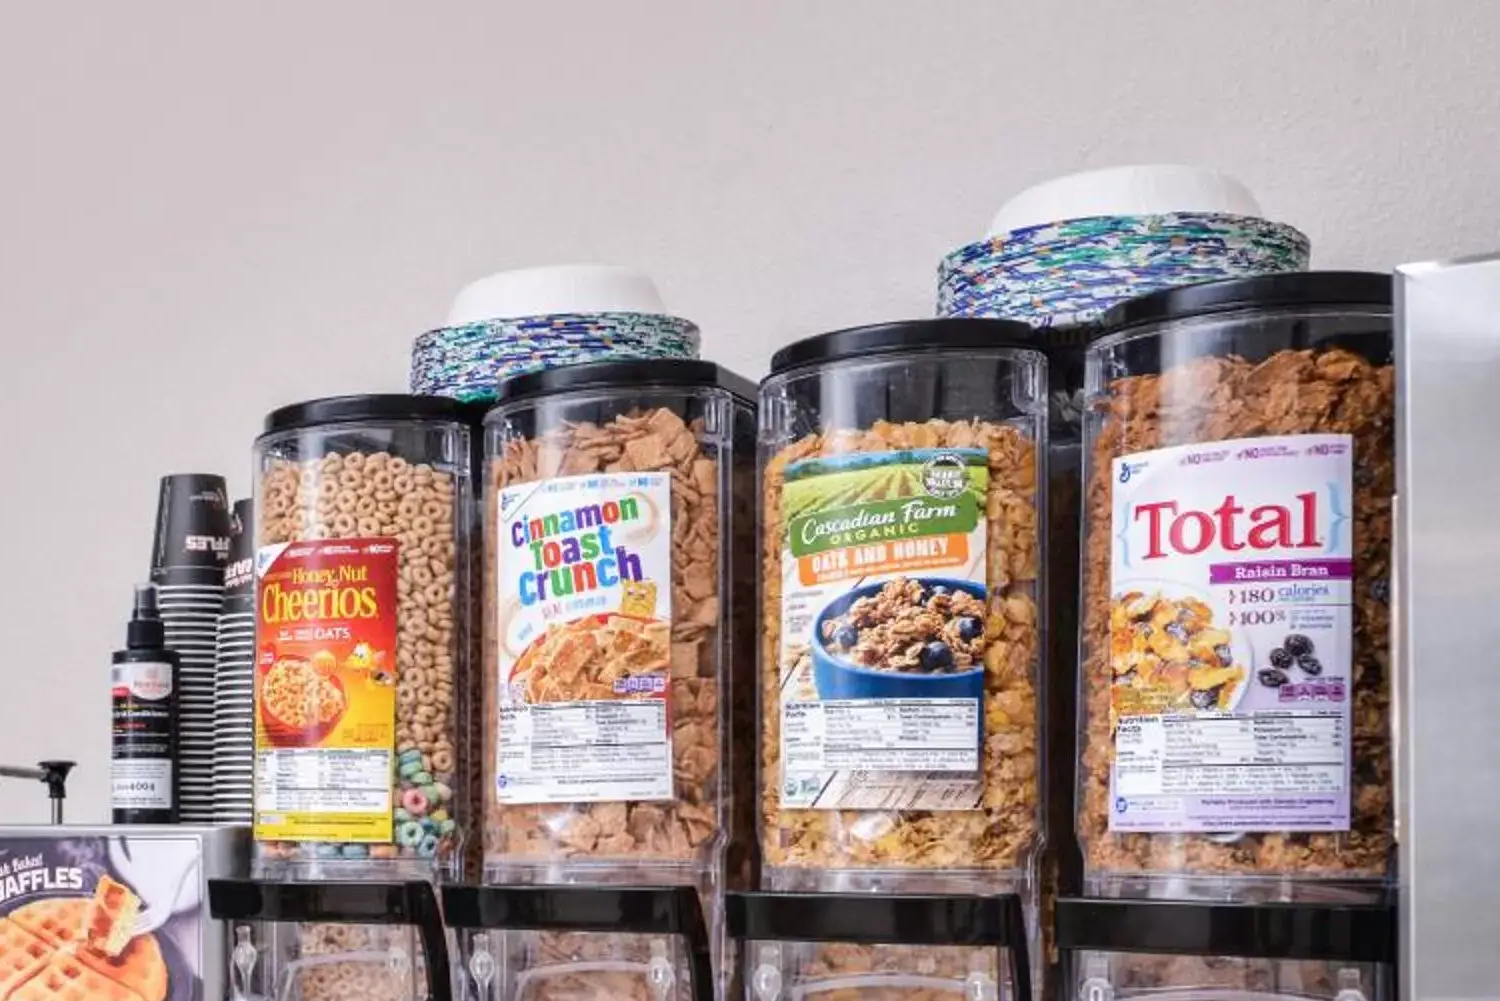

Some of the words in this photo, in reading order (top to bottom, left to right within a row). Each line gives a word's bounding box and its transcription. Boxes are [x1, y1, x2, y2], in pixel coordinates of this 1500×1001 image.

[801, 509, 895, 545] Cascadian
[900, 499, 957, 522] Farm
[1134, 491, 1322, 560] Total
[829, 523, 919, 545] ORGANIC
[893, 537, 948, 560] HONEY
[292, 566, 335, 586] Honey
[340, 564, 368, 581] Nut
[1235, 566, 1287, 580] Raisin
[1290, 564, 1329, 578] Bran
[263, 582, 377, 624] Cheerios
[1239, 588, 1275, 605] 180
[313, 627, 351, 640] OATS
